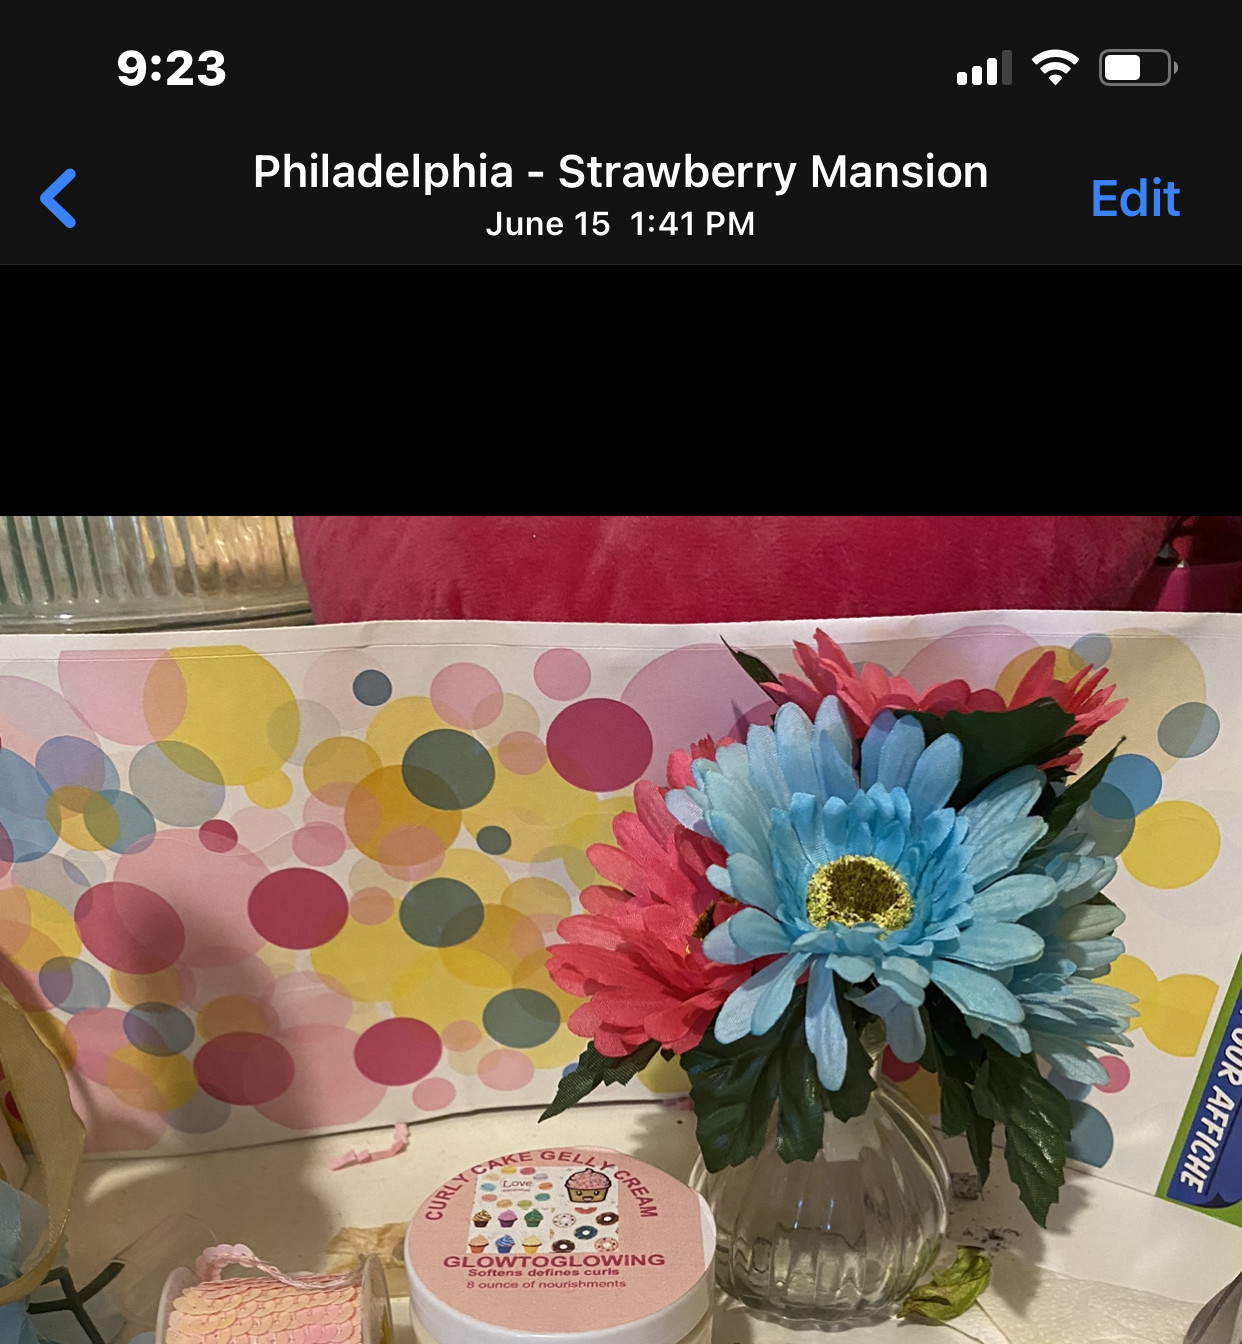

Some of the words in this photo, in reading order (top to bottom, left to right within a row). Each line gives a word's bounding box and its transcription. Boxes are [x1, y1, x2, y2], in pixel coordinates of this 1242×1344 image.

[117, 49, 226, 87] 9:23
[255, 153, 513, 196] Philadelphia
[527, 170, 544, 179] -
[558, 153, 797, 197] Strawberry
[812, 152, 988, 189] Mansion
[1092, 176, 1181, 218] Edit
[485, 211, 564, 237] June
[574, 211, 611, 236] 15
[630, 211, 693, 236] 1:41
[706, 211, 754, 236] PM
[1180, 1085, 1235, 1194] AFFICHE
[425, 1172, 470, 1221] CURLY
[471, 1151, 533, 1175] CAKE
[540, 1150, 615, 1171] GELLY
[613, 1169, 659, 1218] CREAM
[443, 1253, 666, 1268] GLOWTOGLOWING
[467, 1268, 523, 1277] Softens
[527, 1268, 580, 1277] defines
[583, 1267, 620, 1277] curls
[466, 1281, 475, 1289] 8
[478, 1281, 519, 1289] ounce
[522, 1280, 536, 1289] of
[538, 1279, 627, 1288] nourishments
